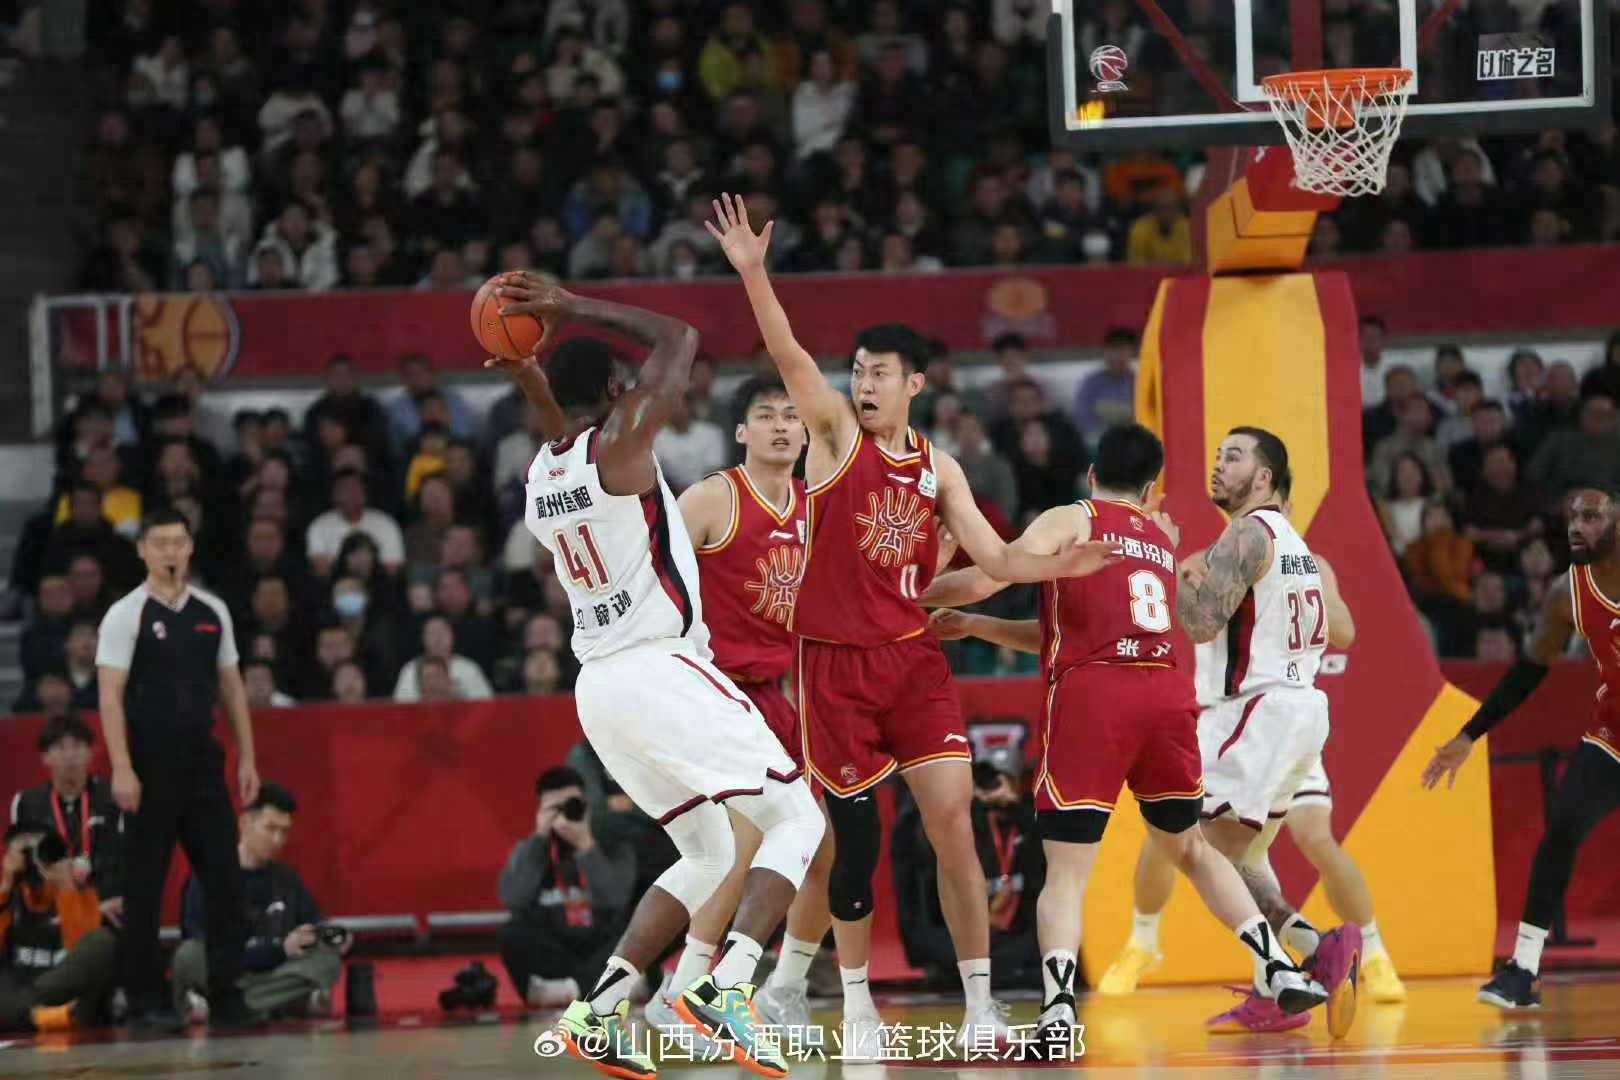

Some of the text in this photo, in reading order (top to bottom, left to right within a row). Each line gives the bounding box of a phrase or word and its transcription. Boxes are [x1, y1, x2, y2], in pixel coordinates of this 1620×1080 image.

[555, 520, 611, 593] 41
[1128, 570, 1171, 633] 8
[1286, 587, 1328, 652] 32
